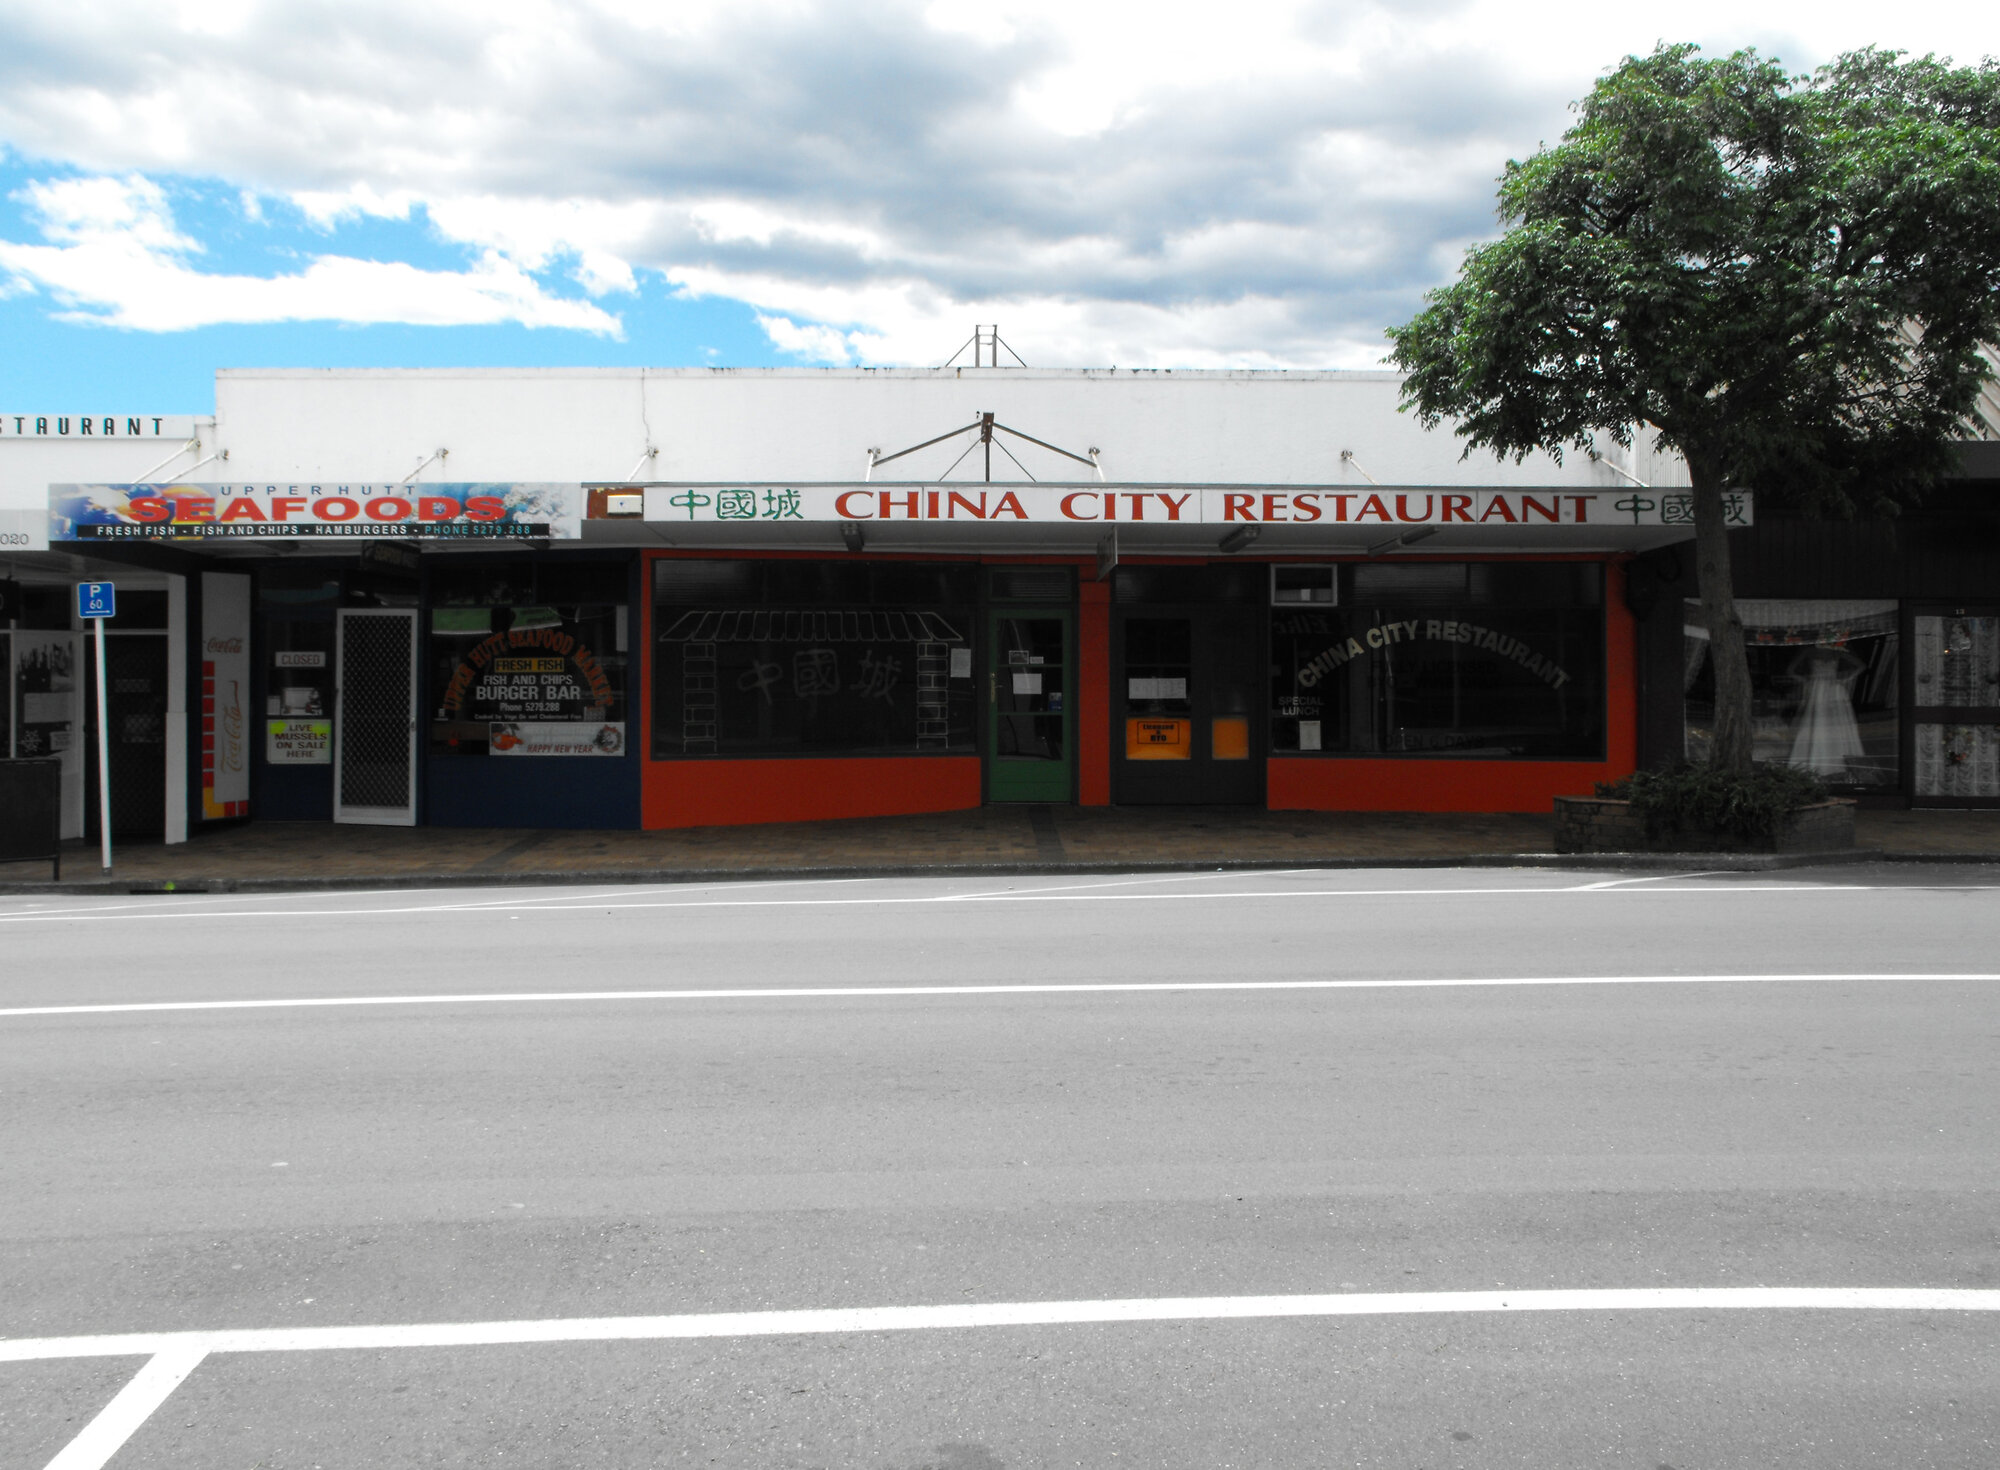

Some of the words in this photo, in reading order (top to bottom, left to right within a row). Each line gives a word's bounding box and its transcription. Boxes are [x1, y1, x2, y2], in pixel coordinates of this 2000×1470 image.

[0, 417, 163, 436] TAURANT
[220, 485, 322, 496] UPPER
[338, 485, 416, 496] HUTT
[128, 496, 507, 523] SEAFOODS
[669, 488, 804, 521] 中國城
[834, 491, 1030, 520] CHINA
[1059, 492, 1193, 521] CITY
[1223, 493, 1598, 523] RESTAURANT
[97, 525, 141, 536] FRESH
[145, 525, 176, 536] FISH
[193, 525, 224, 536] FISH
[227, 525, 255, 536] AND
[258, 525, 299, 536] CHIPS
[315, 525, 408, 535] HAMBURGERS
[424, 525, 469, 535] PHONE
[472, 525, 531, 535] 5279.288
[89, 585, 101, 598] P
[89, 599, 104, 610] 60
[281, 653, 321, 666] CLOSED
[1297, 636, 1366, 688] CHINA
[1366, 619, 1419, 649] CITY
[1426, 619, 1573, 690] RESTAURANT
[442, 662, 477, 712] UPPER
[467, 632, 507, 669] HUTT
[508, 628, 575, 656] SEAFOOD
[495, 659, 532, 672] FRESH
[537, 659, 564, 672] FISH
[483, 674, 507, 686] FISH
[512, 674, 536, 686] AND
[540, 674, 573, 686] CHIPS
[475, 686, 539, 701] BURGER
[546, 686, 581, 701] BAR
[1277, 695, 1325, 706] SPECIAL
[499, 702, 523, 712] Phone
[1281, 706, 1320, 716] LUNCH
[288, 724, 313, 732] LIVE
[274, 732, 328, 740] MUSSELS
[276, 741, 293, 750] ON
[297, 741, 327, 750] SALE
[554, 743, 572, 754] NEW
[573, 743, 594, 754] YEAR
[286, 750, 315, 758] HERE
